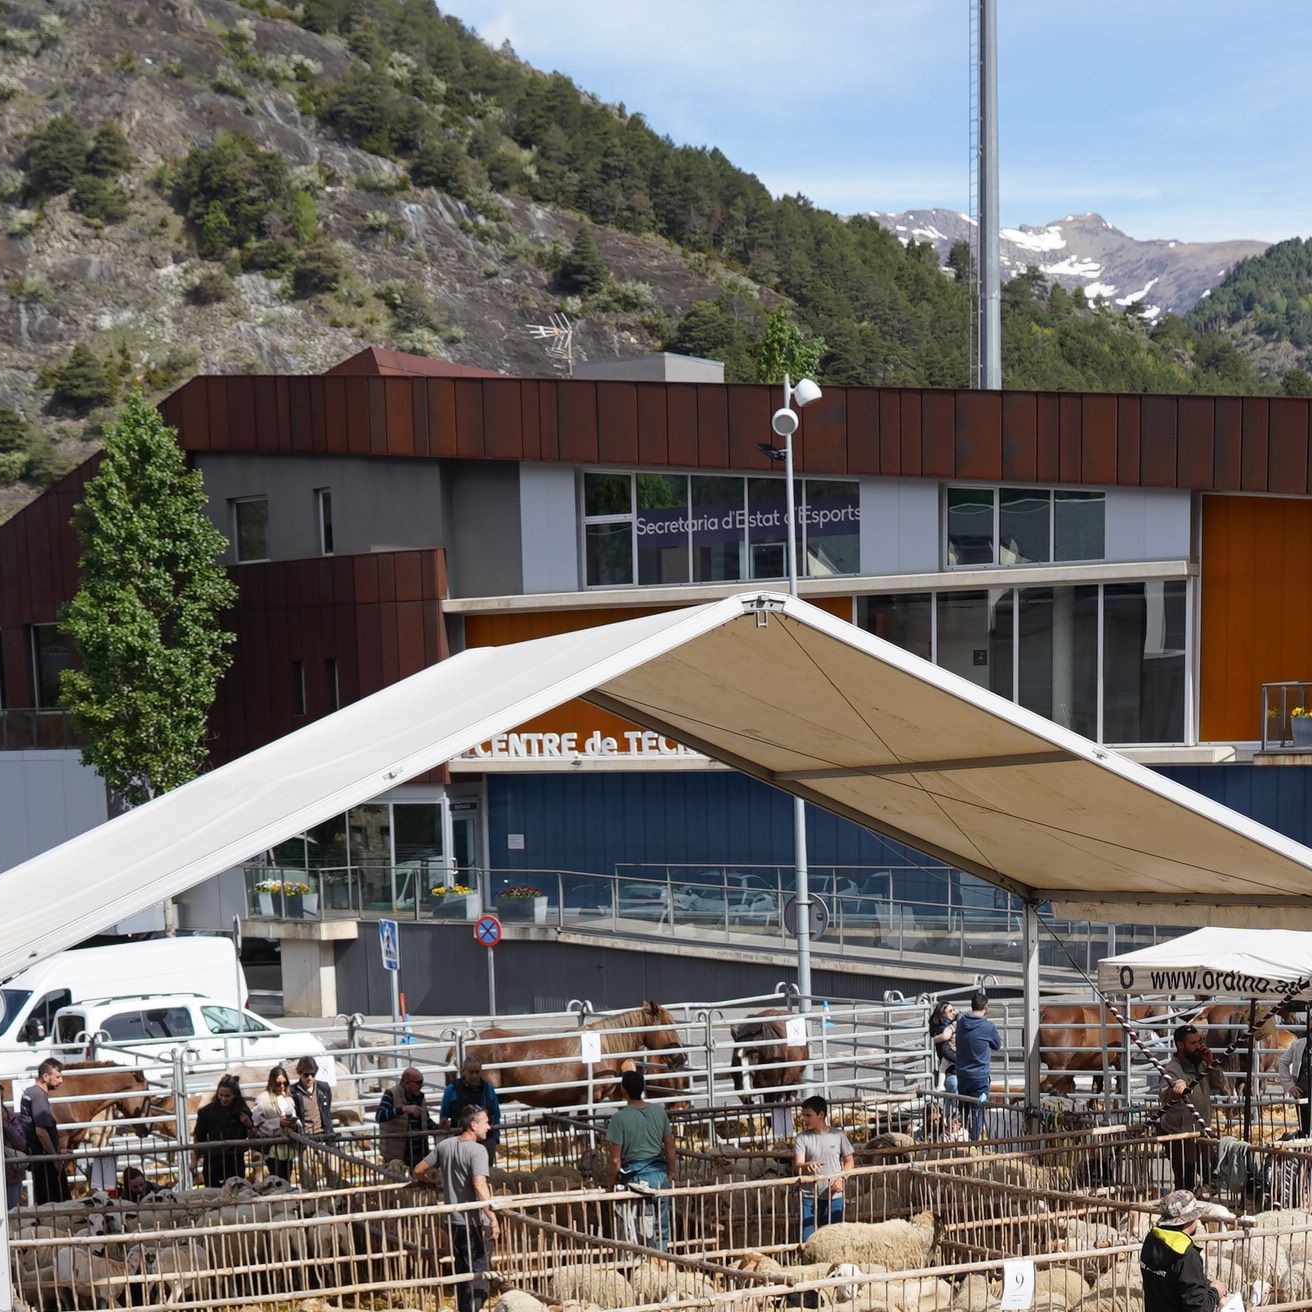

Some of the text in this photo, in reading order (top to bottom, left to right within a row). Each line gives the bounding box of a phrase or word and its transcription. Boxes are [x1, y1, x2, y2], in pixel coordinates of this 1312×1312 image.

[636, 514, 719, 536] Secretaria
[721, 508, 781, 530] d'Estat
[474, 732, 578, 757] CENTRE
[584, 730, 618, 756] de
[1015, 1272, 1025, 1289] 9
